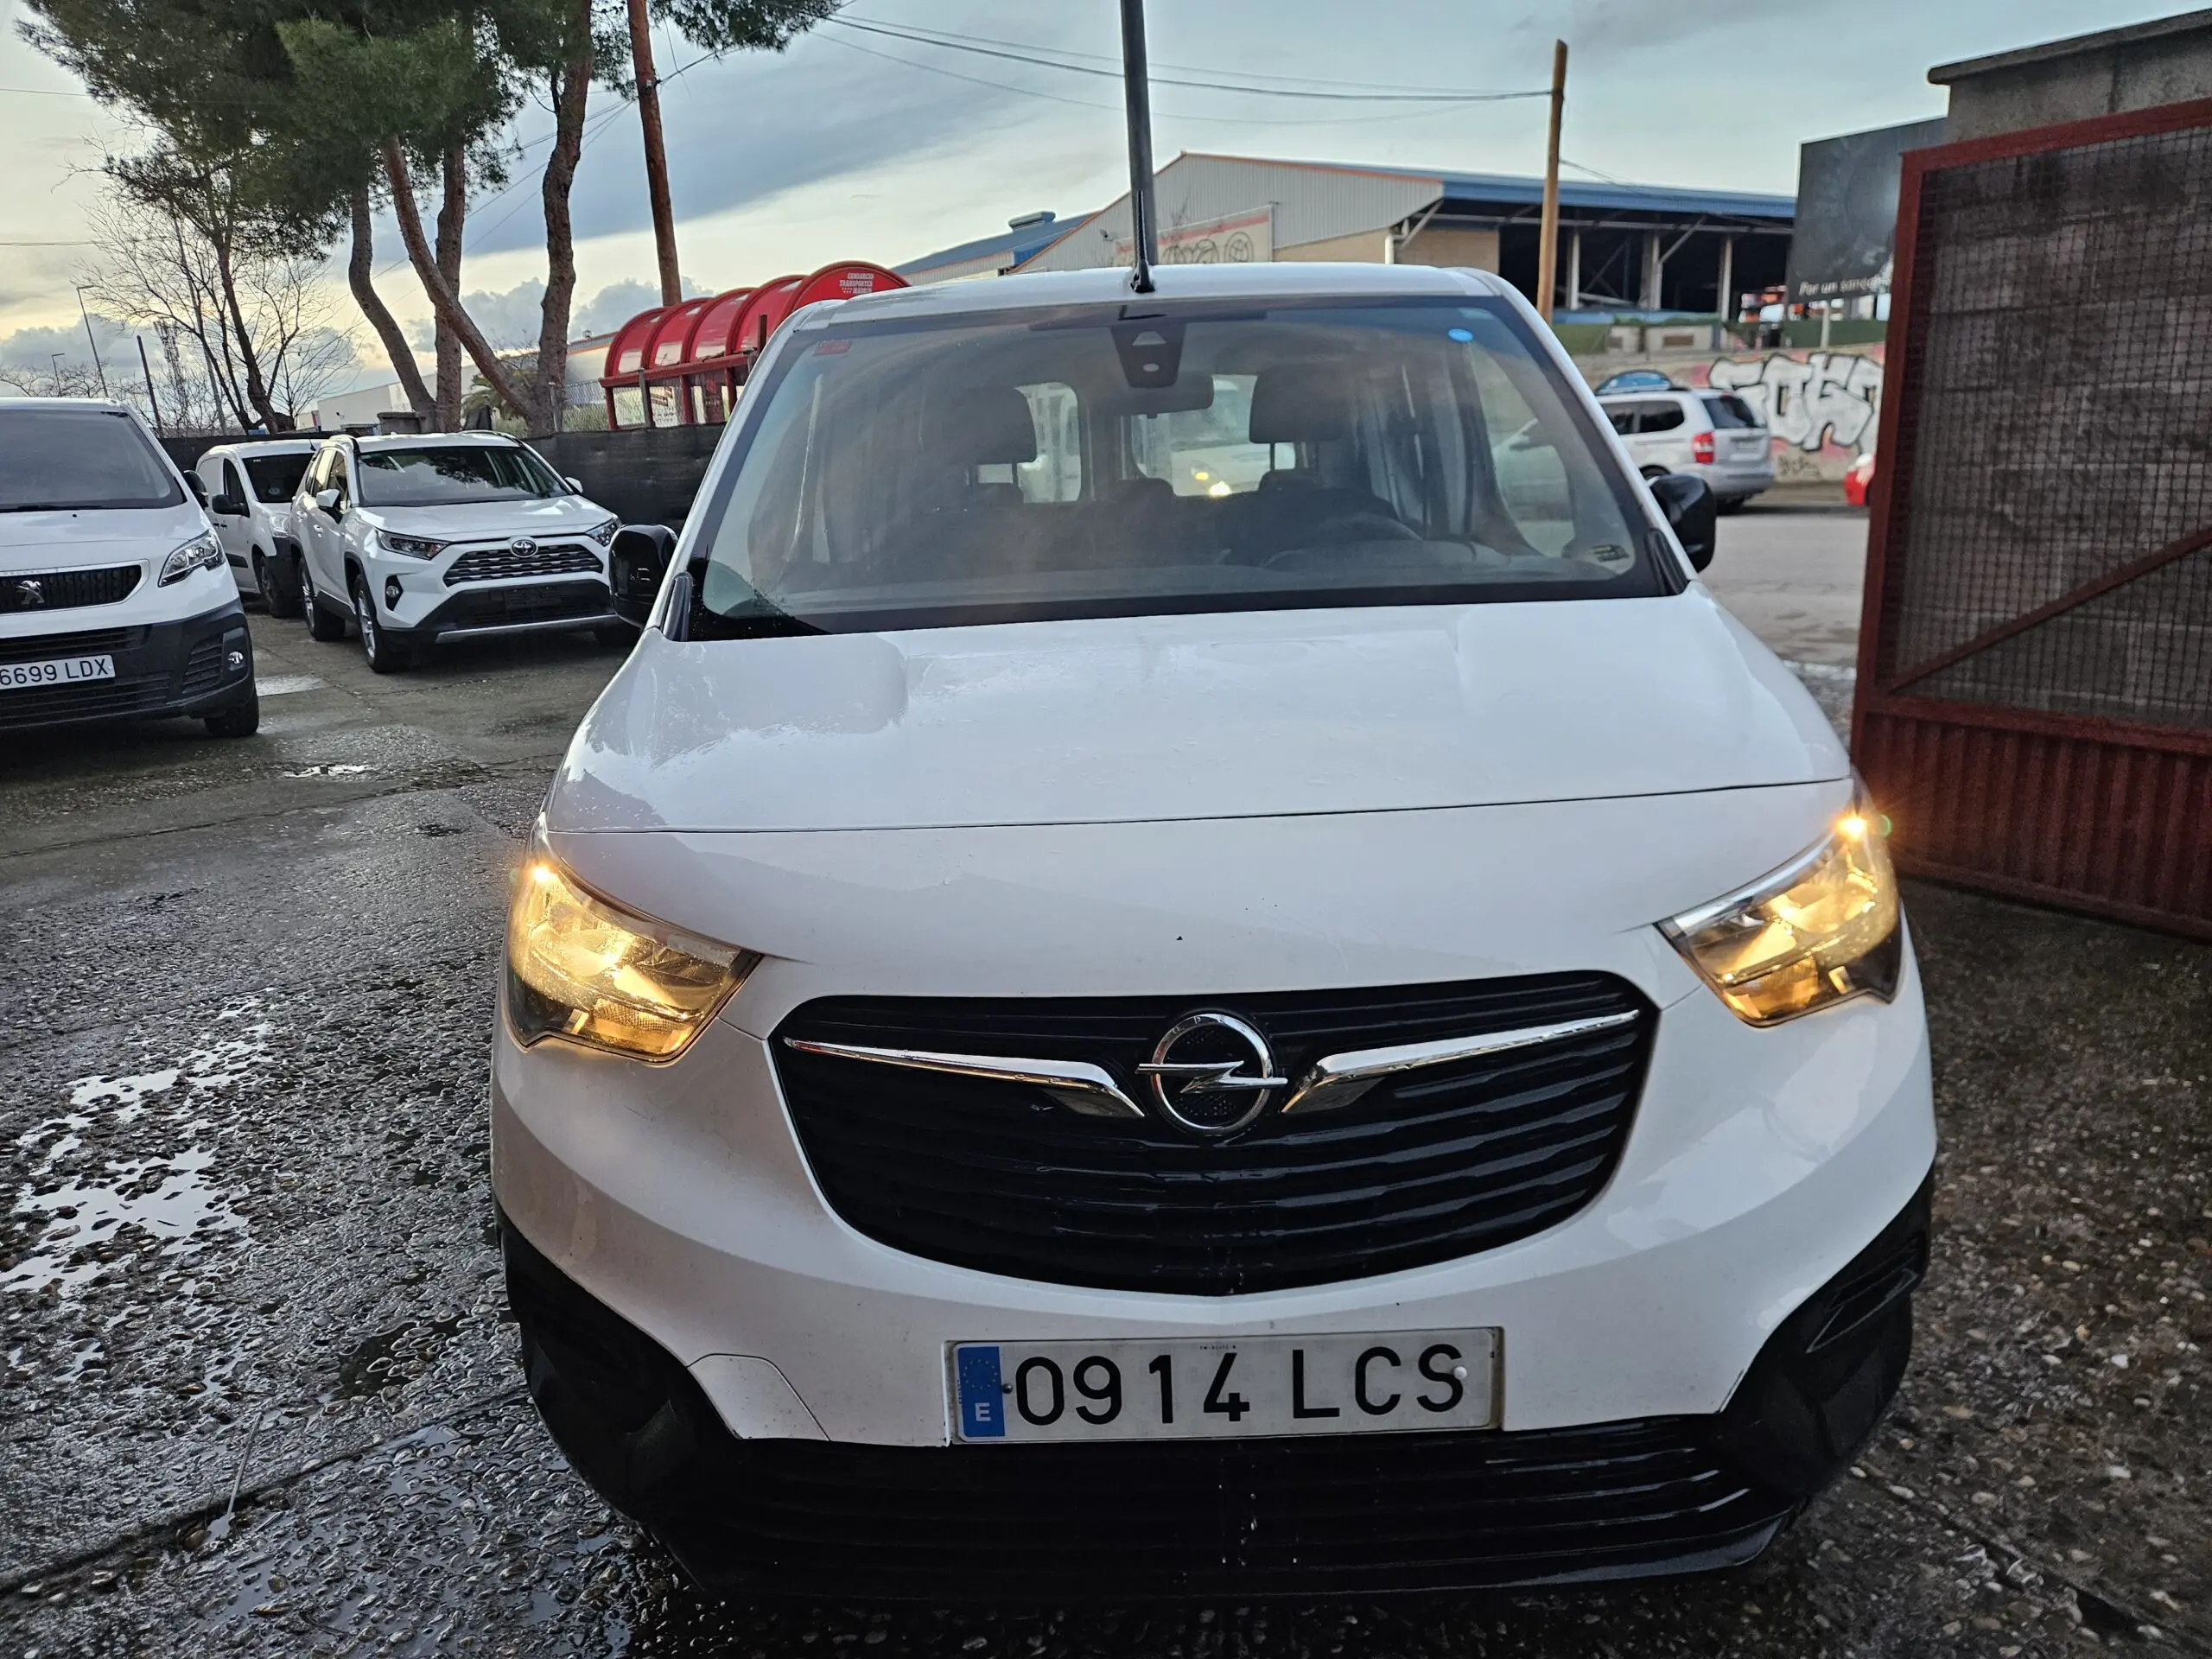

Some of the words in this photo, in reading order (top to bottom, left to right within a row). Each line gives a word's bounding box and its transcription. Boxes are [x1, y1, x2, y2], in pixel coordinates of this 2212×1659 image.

[1799, 282, 1819, 296] Por
[1821, 282, 1838, 294] un
[0, 664, 57, 685] 6699
[65, 658, 108, 679] LDX
[1016, 1352, 1249, 1426] 0914
[1293, 1344, 1464, 1419] LCS
[975, 1402, 991, 1421] E
